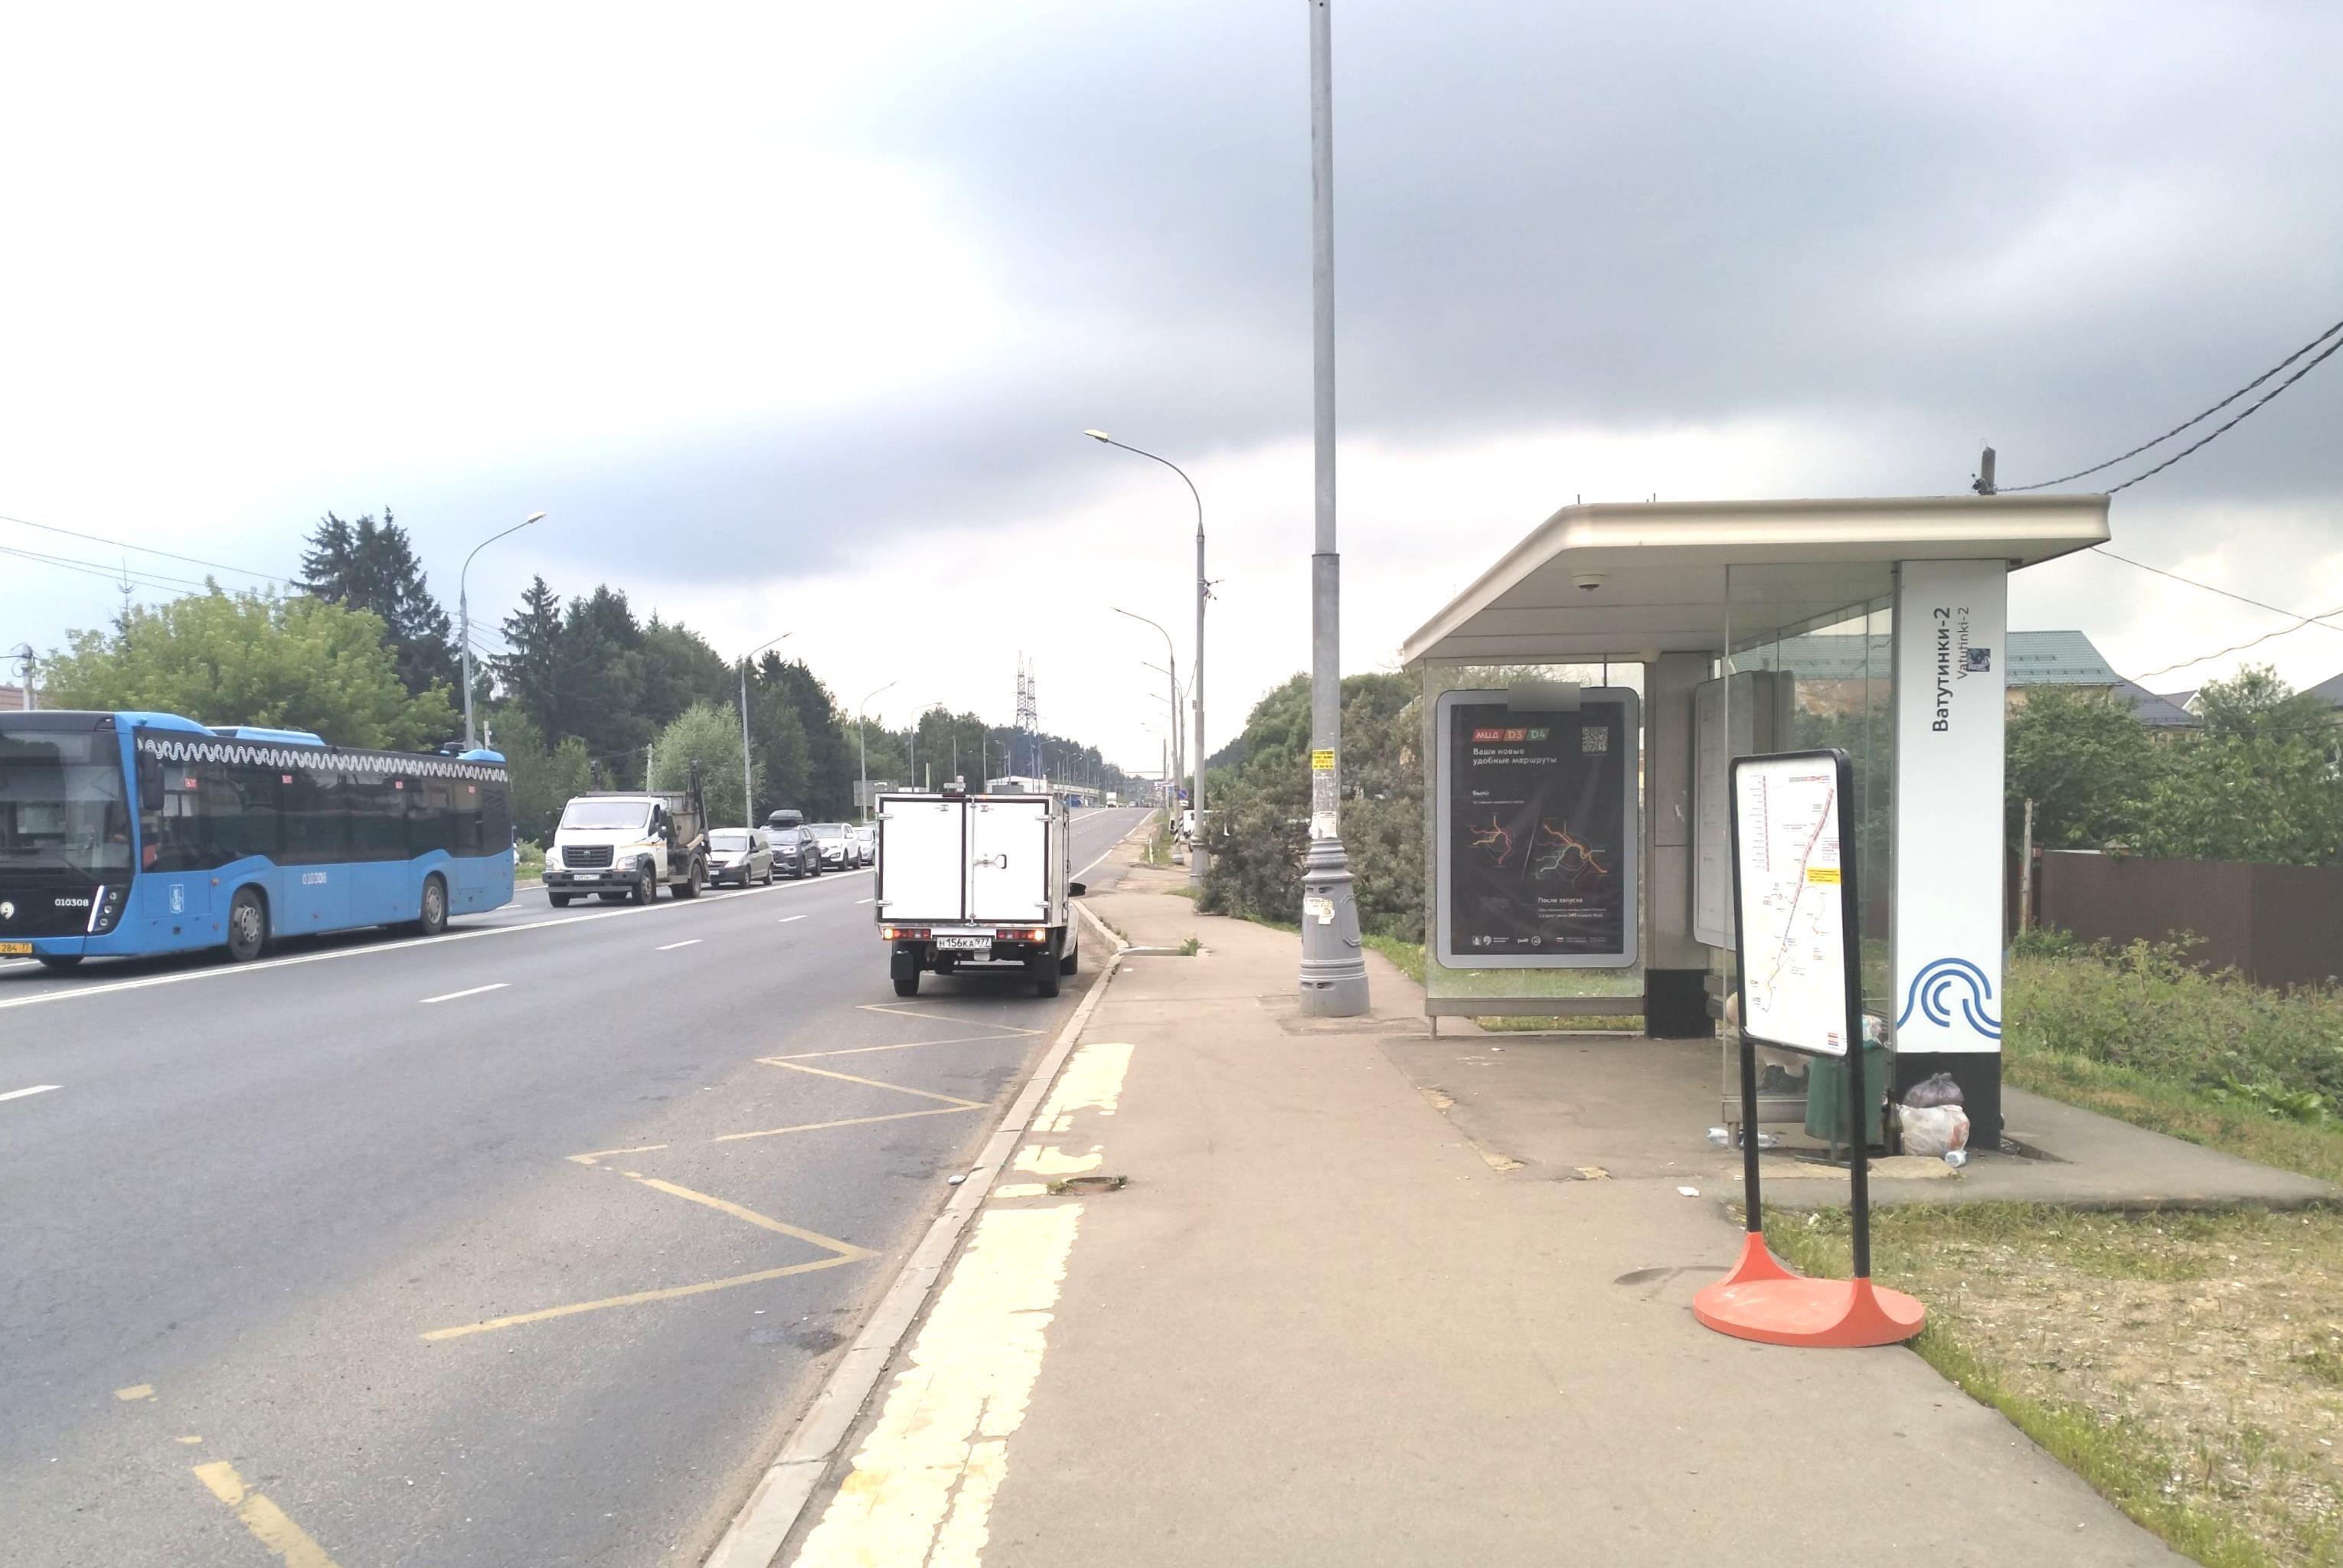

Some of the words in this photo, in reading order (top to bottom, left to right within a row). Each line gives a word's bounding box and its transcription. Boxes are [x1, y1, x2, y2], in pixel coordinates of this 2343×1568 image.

[1932, 607, 1953, 731] Ватутинки-2
[1508, 730, 1523, 739] D3
[1531, 730, 1545, 739] D4
[1472, 756, 1509, 766] удобные
[54, 898, 89, 906] 010308
